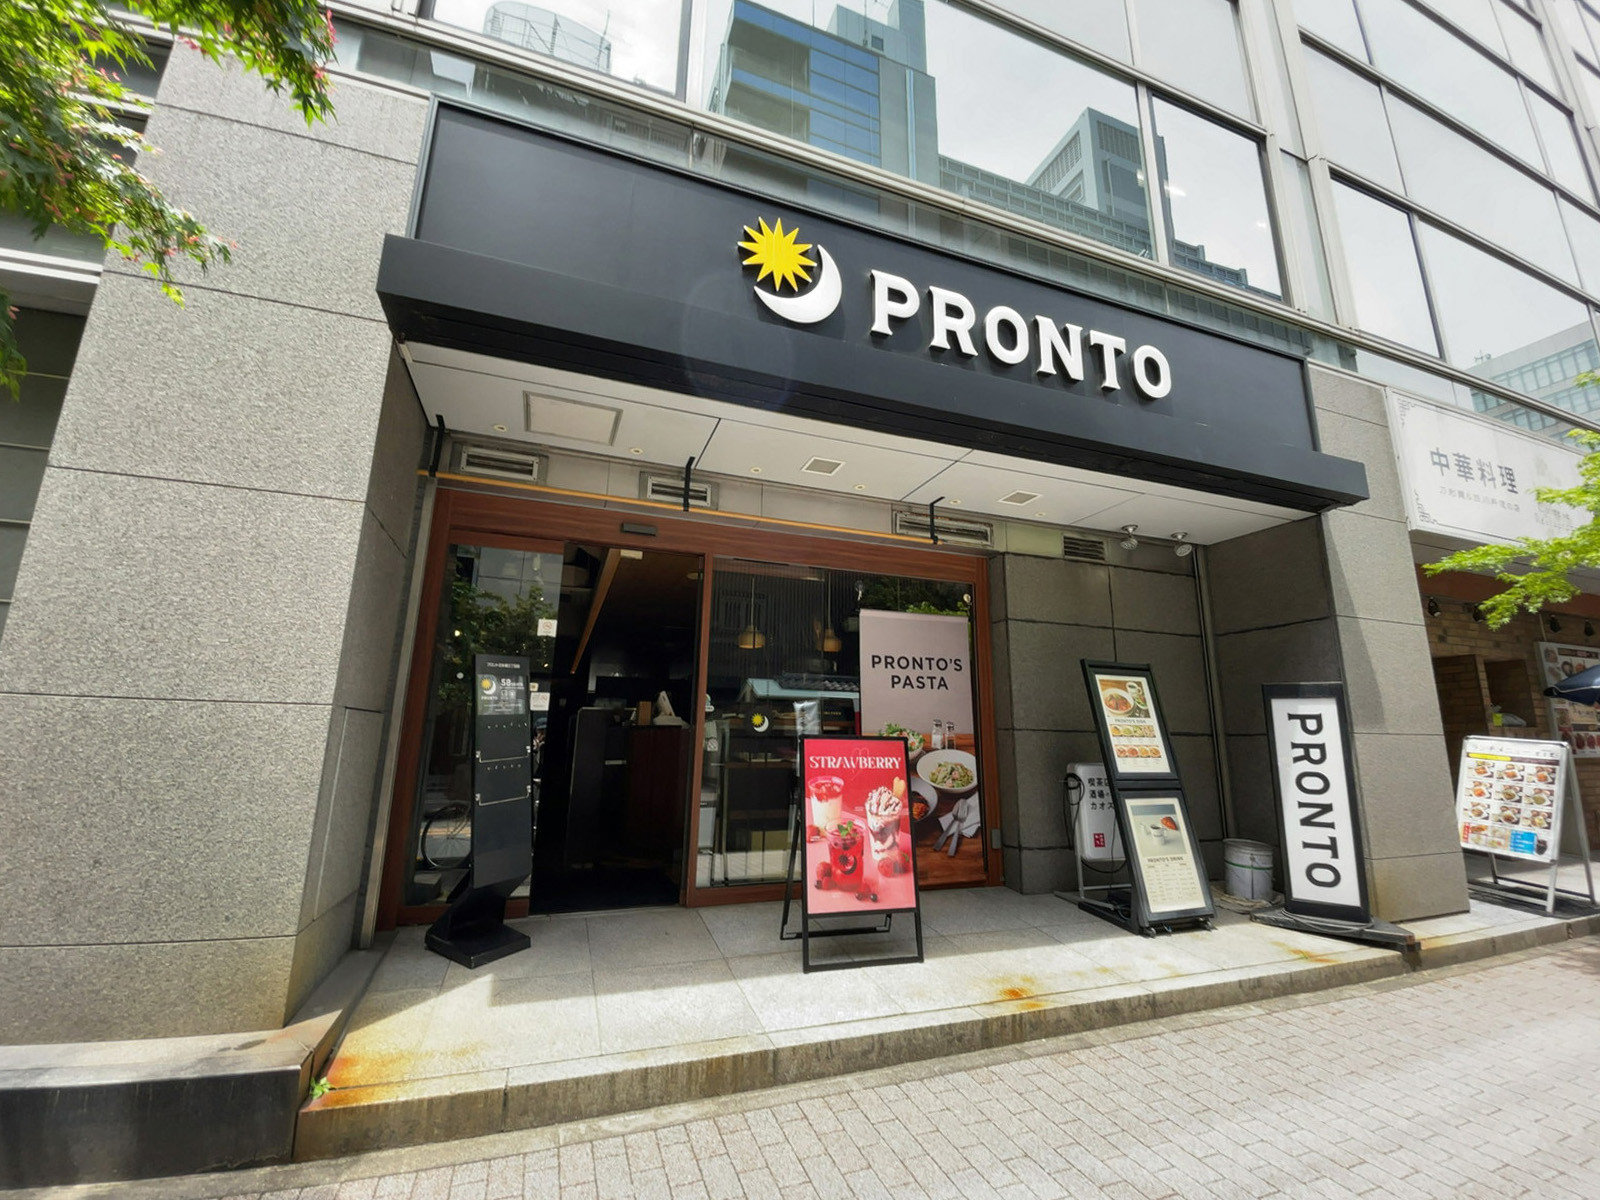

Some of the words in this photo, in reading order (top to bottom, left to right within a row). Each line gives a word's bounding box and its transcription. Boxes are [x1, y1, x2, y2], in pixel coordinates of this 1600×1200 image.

[870, 269, 1172, 399] PRONTO
[1429, 447, 1519, 494] 中華料理
[871, 655, 963, 672] PRONTO'S
[891, 675, 949, 690] PASTA
[809, 756, 901, 769] STRAWBERRY
[1287, 713, 1341, 888] PRONTO
